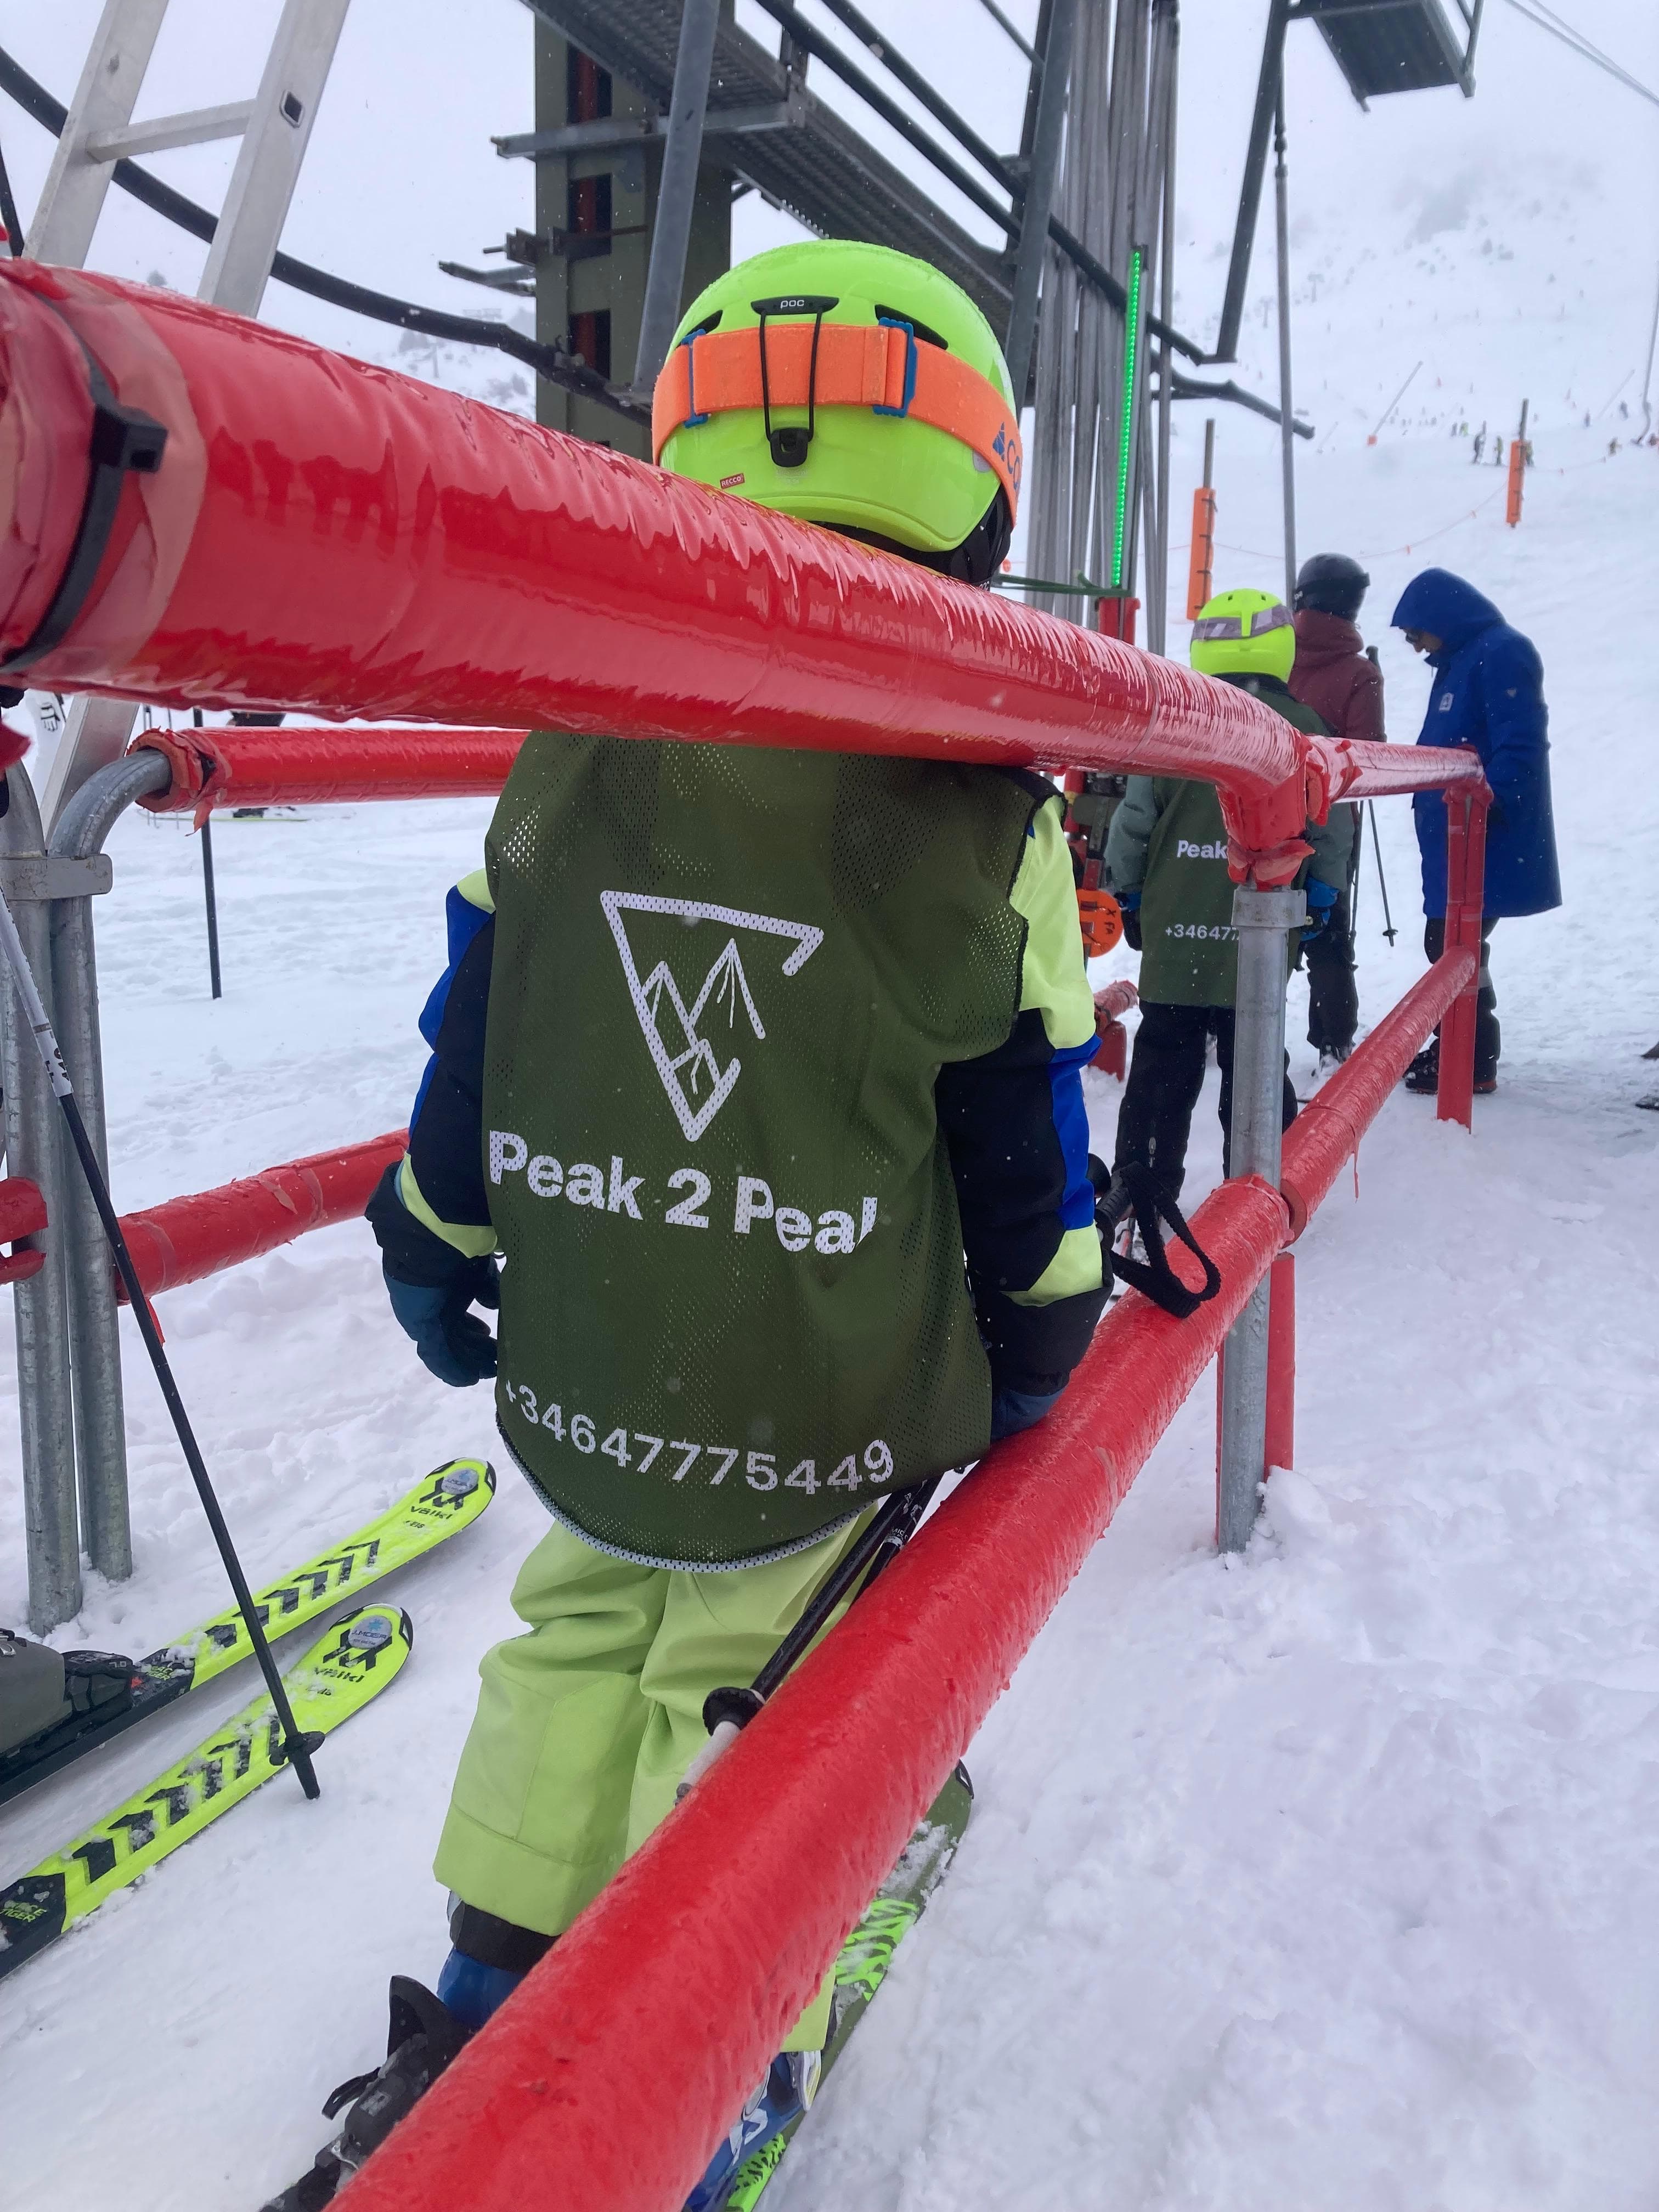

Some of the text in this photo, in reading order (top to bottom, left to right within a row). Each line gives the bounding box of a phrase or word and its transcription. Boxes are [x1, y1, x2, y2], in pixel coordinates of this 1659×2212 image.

[780, 299, 805, 309] poc
[721, 476, 742, 487] RECCO
[1177, 839, 1228, 859] Peak
[489, 1130, 646, 1220] Peak
[665, 1168, 712, 1228] 2
[505, 1380, 894, 1495] +34647775449
